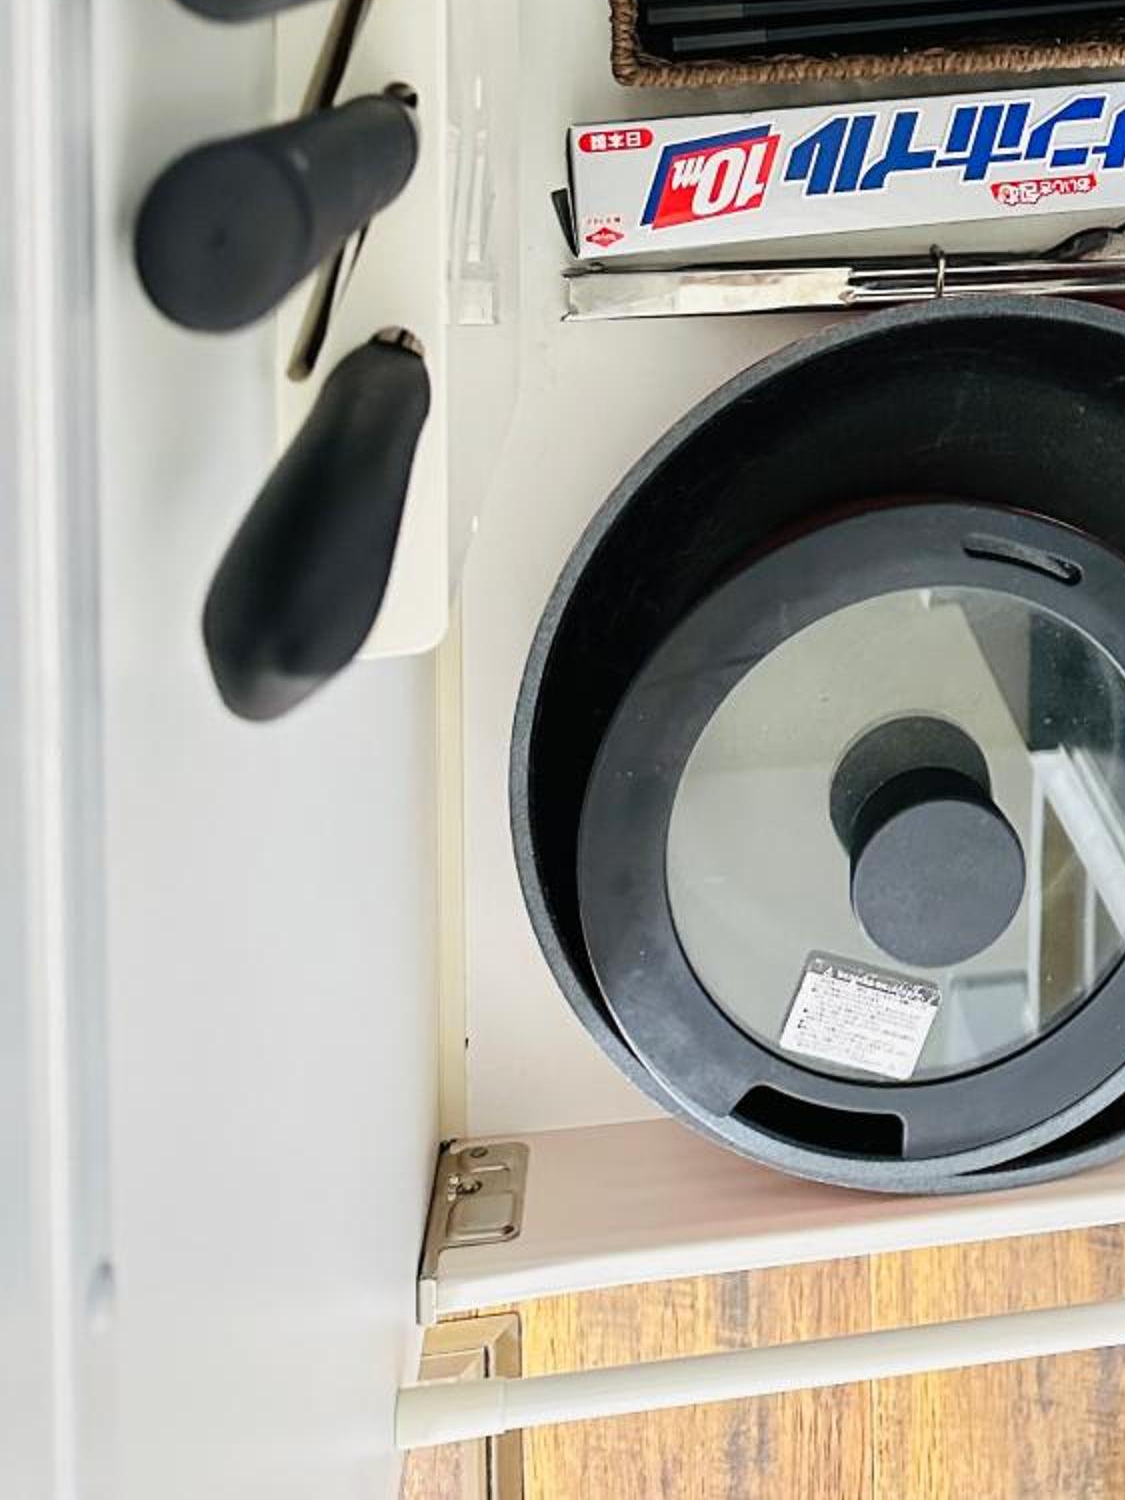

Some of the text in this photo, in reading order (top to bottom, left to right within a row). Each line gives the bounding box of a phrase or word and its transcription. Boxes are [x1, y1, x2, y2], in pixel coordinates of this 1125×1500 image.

[591, 132, 641, 150] 日本製
[672, 143, 768, 215] 10m
